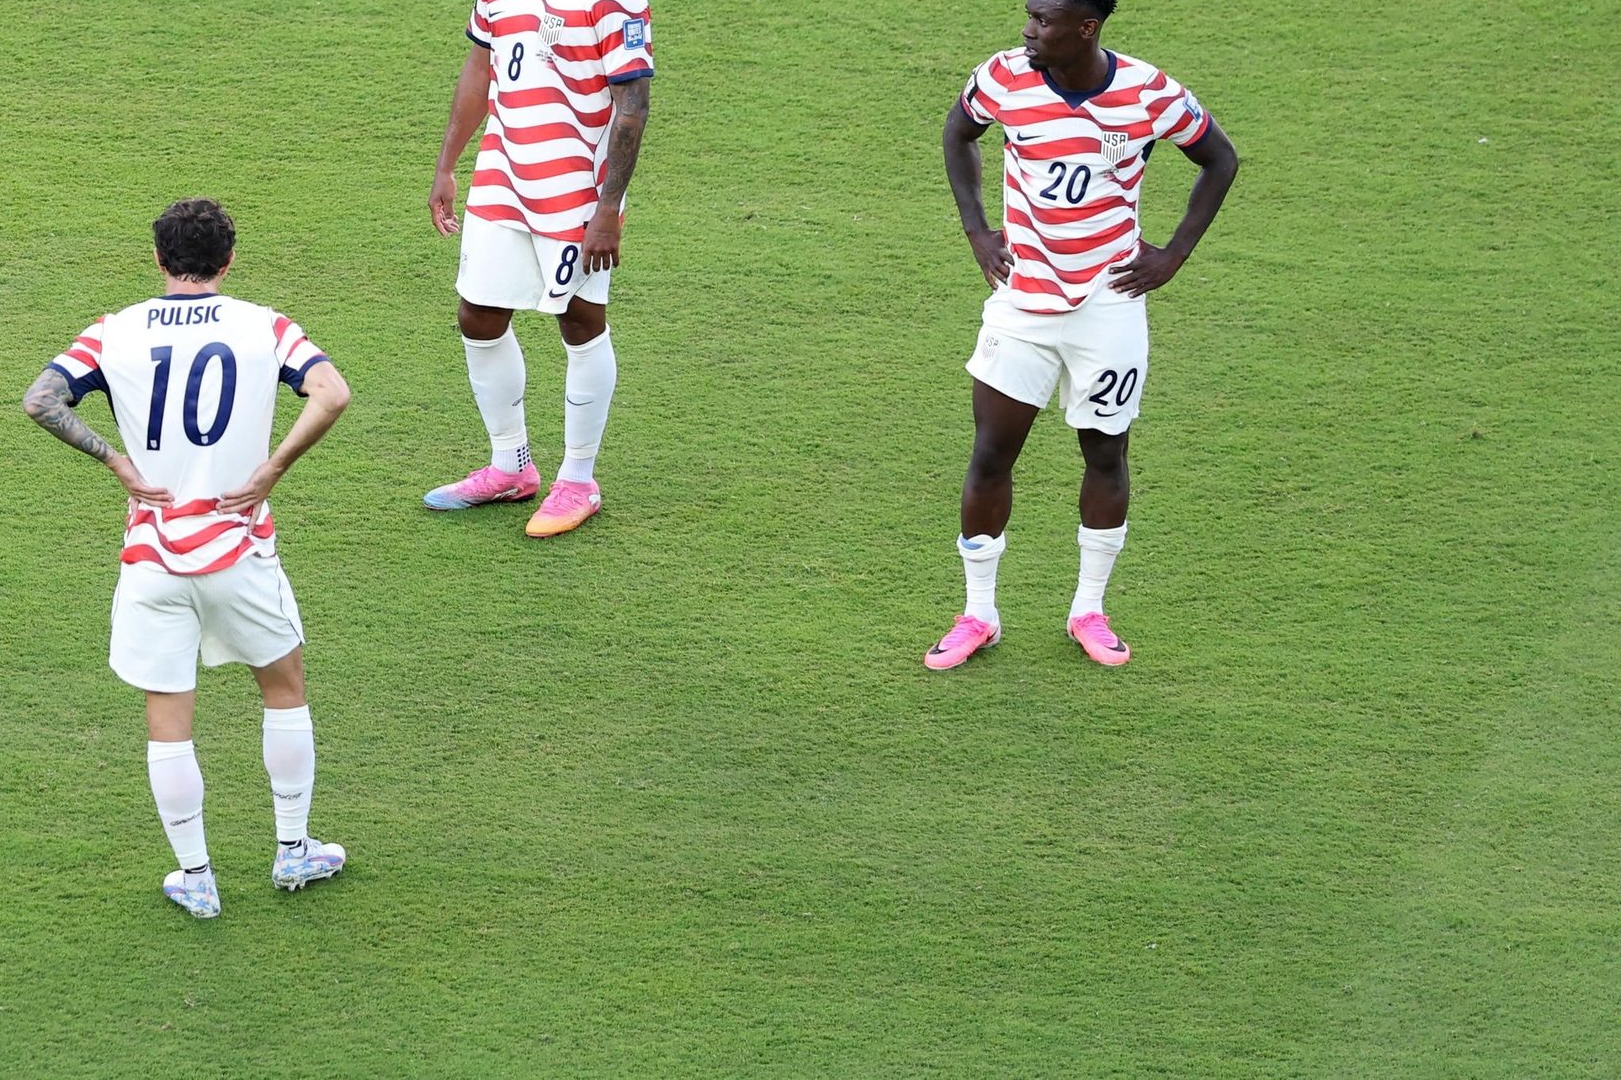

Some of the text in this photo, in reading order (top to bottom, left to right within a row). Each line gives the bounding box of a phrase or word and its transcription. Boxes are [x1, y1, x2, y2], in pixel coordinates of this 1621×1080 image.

[543, 14, 563, 29] USA
[508, 42, 524, 81] 8
[1103, 133, 1127, 147] USA
[1039, 161, 1091, 204] 20
[555, 244, 579, 286] 8
[147, 304, 223, 329] PULISIC
[146, 341, 237, 451] 10
[1088, 367, 1138, 407] 20
